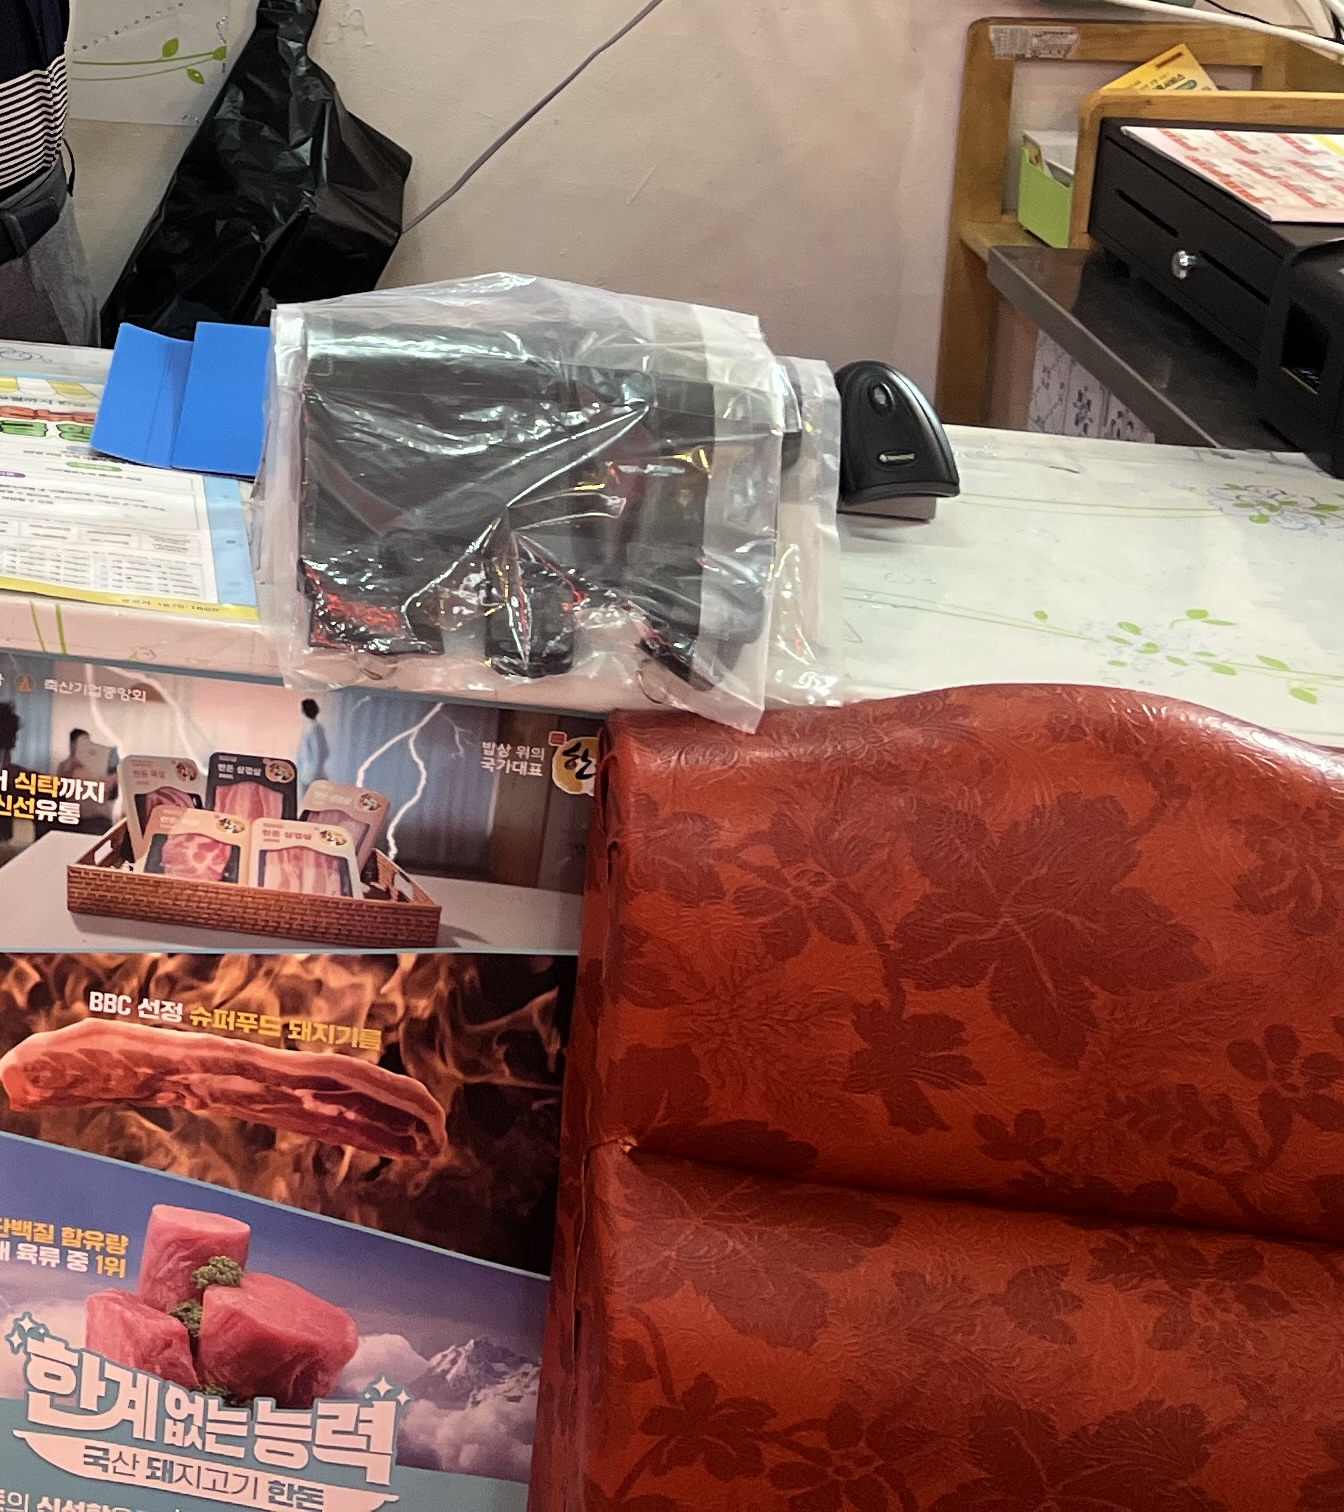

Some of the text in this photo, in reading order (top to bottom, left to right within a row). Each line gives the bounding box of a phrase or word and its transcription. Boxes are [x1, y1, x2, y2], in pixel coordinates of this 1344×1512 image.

[479, 755, 545, 778] 국가대표
[481, 738, 547, 763] 밥상 위의
[13, 771, 107, 805] 식탁까지
[88, 990, 383, 1052] BBC 선정 슈퍼푸드 돼지기름
[59, 1224, 130, 1258] 함유량
[15, 1242, 61, 1270] 육류
[65, 1248, 88, 1274] 중
[94, 1253, 128, 1279] 1위
[83, 1444, 326, 1509] 국산 돼지고기 한돈
